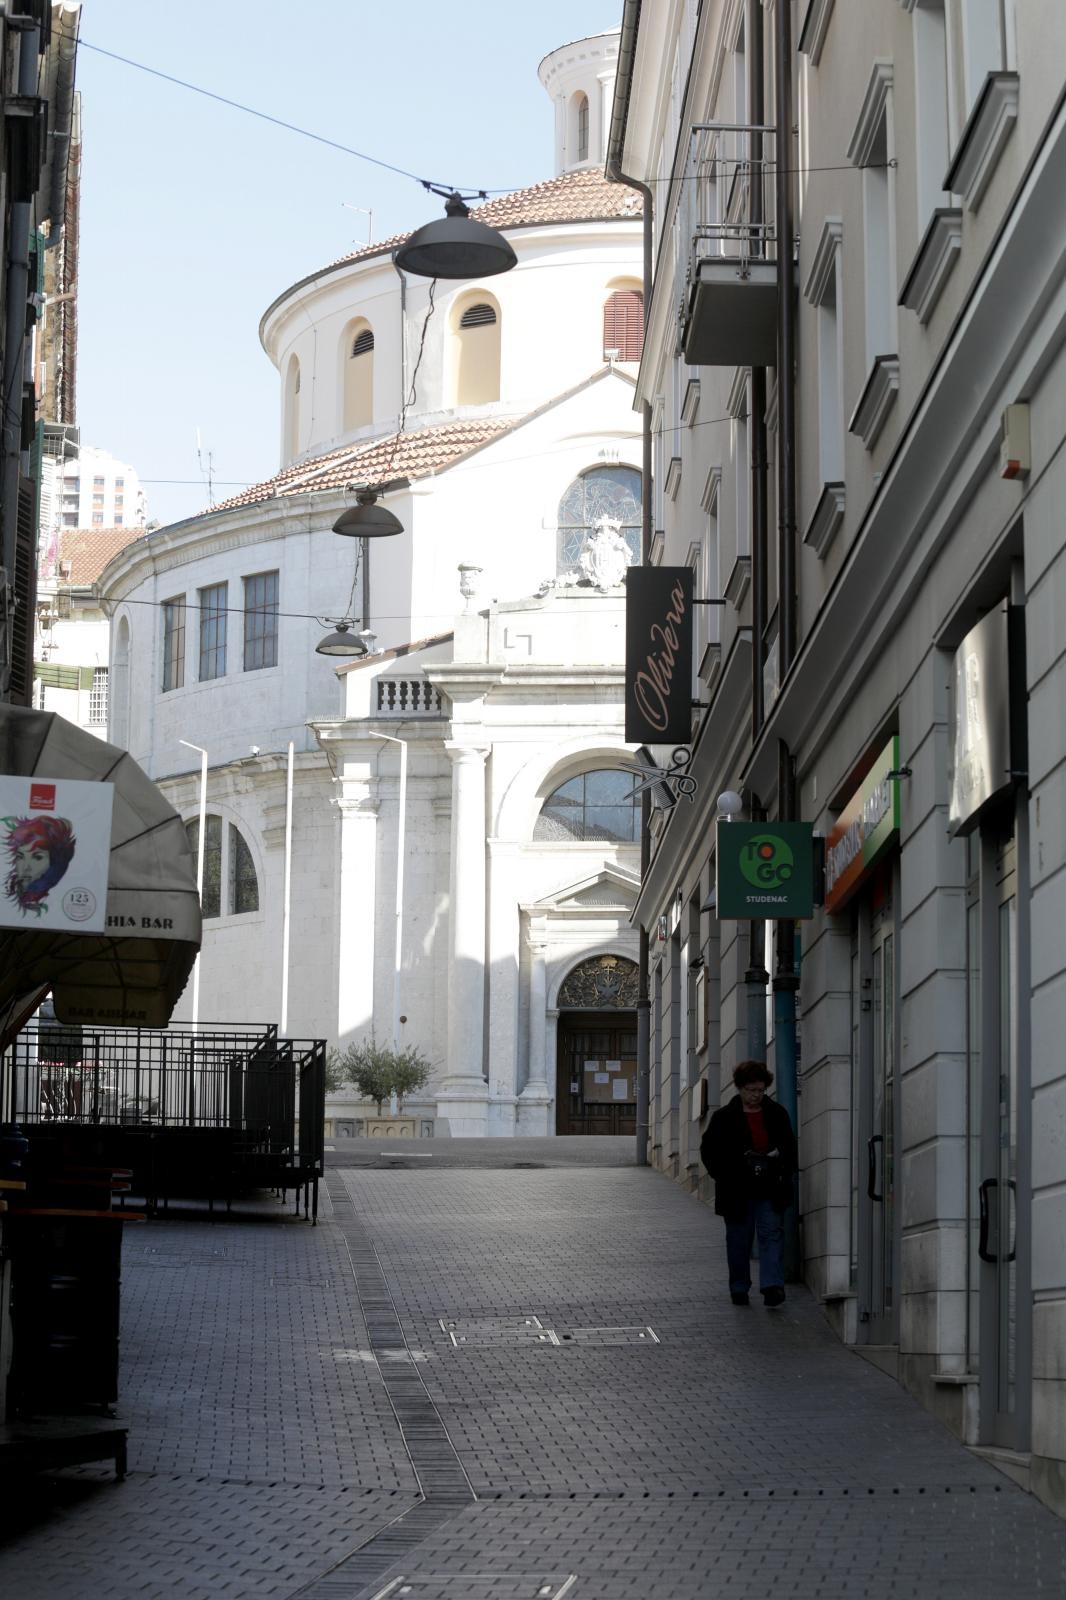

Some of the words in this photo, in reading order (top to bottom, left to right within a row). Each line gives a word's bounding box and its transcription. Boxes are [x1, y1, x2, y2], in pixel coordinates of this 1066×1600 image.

[747, 841, 776, 861] TO
[757, 863, 793, 882] GO
[70, 893, 89, 903] 125
[746, 895, 788, 903] STUDENAC
[105, 915, 137, 927] HIA
[141, 917, 173, 929] BAR
